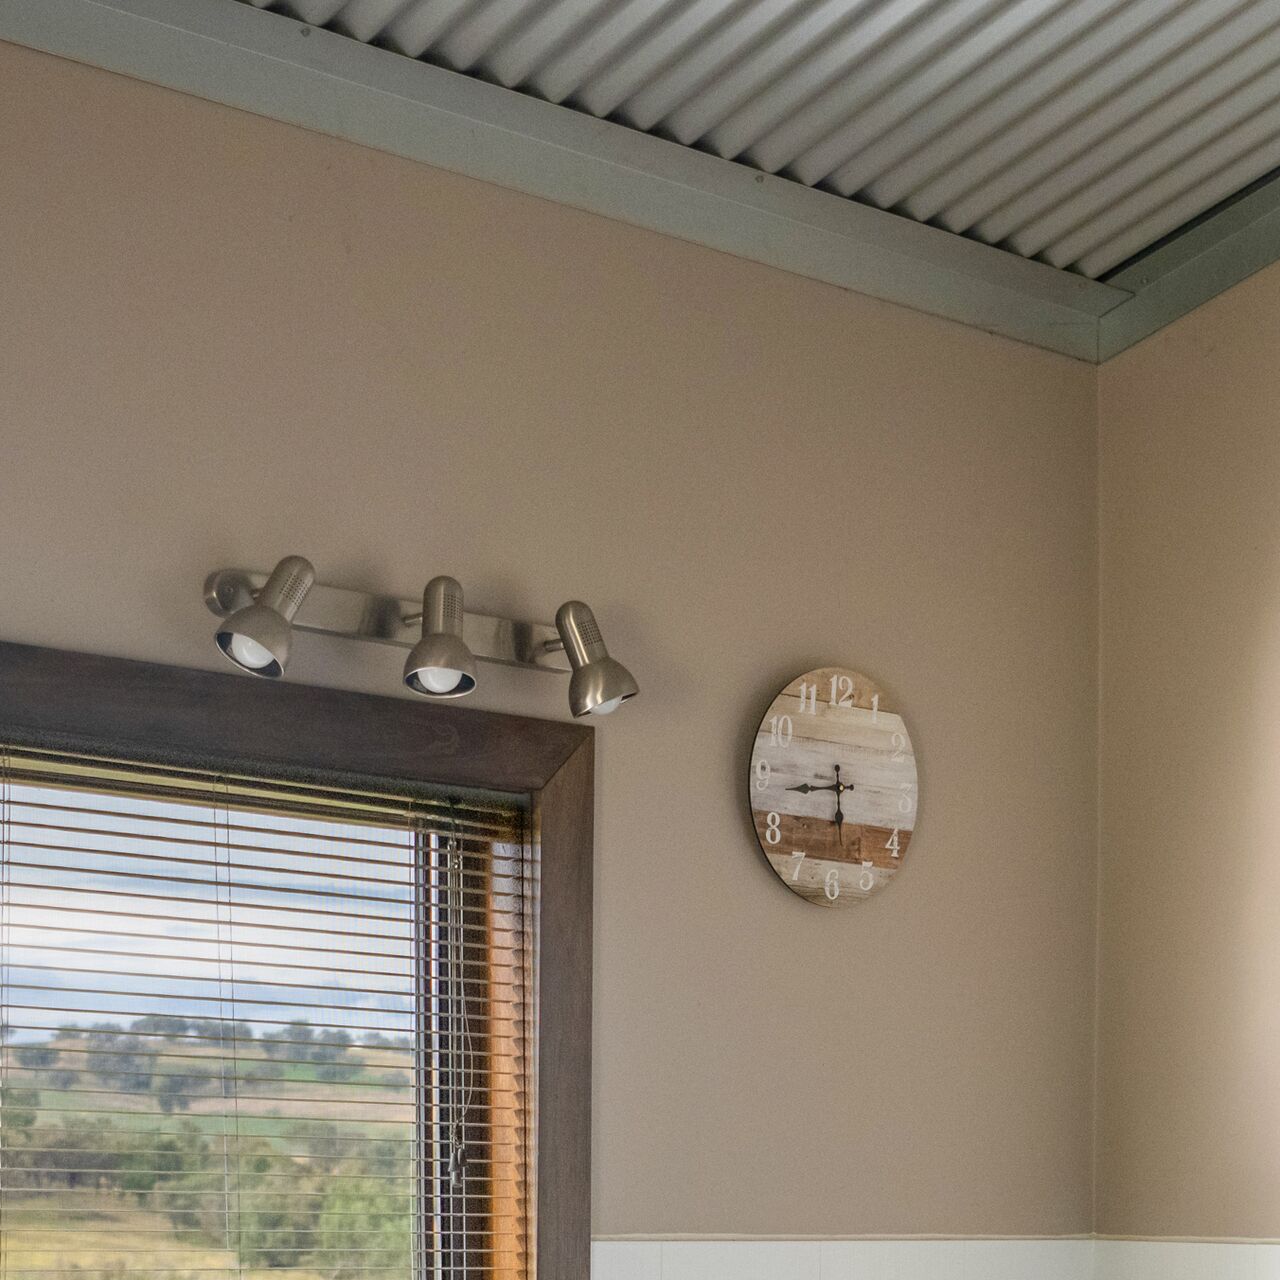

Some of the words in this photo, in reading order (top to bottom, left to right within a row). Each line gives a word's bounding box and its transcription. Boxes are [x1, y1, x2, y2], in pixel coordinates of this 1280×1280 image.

[798, 682, 817, 715] 11
[829, 674, 853, 708] 12
[870, 694, 879, 723] 1
[769, 715, 793, 748] 10
[890, 732, 906, 763] 2
[755, 759, 771, 791] 9
[898, 783, 913, 813] 3
[765, 811, 781, 845] 8
[885, 828, 901, 858] 4
[791, 851, 806, 881] 7
[859, 861, 874, 891] 5
[824, 869, 840, 900] 6
